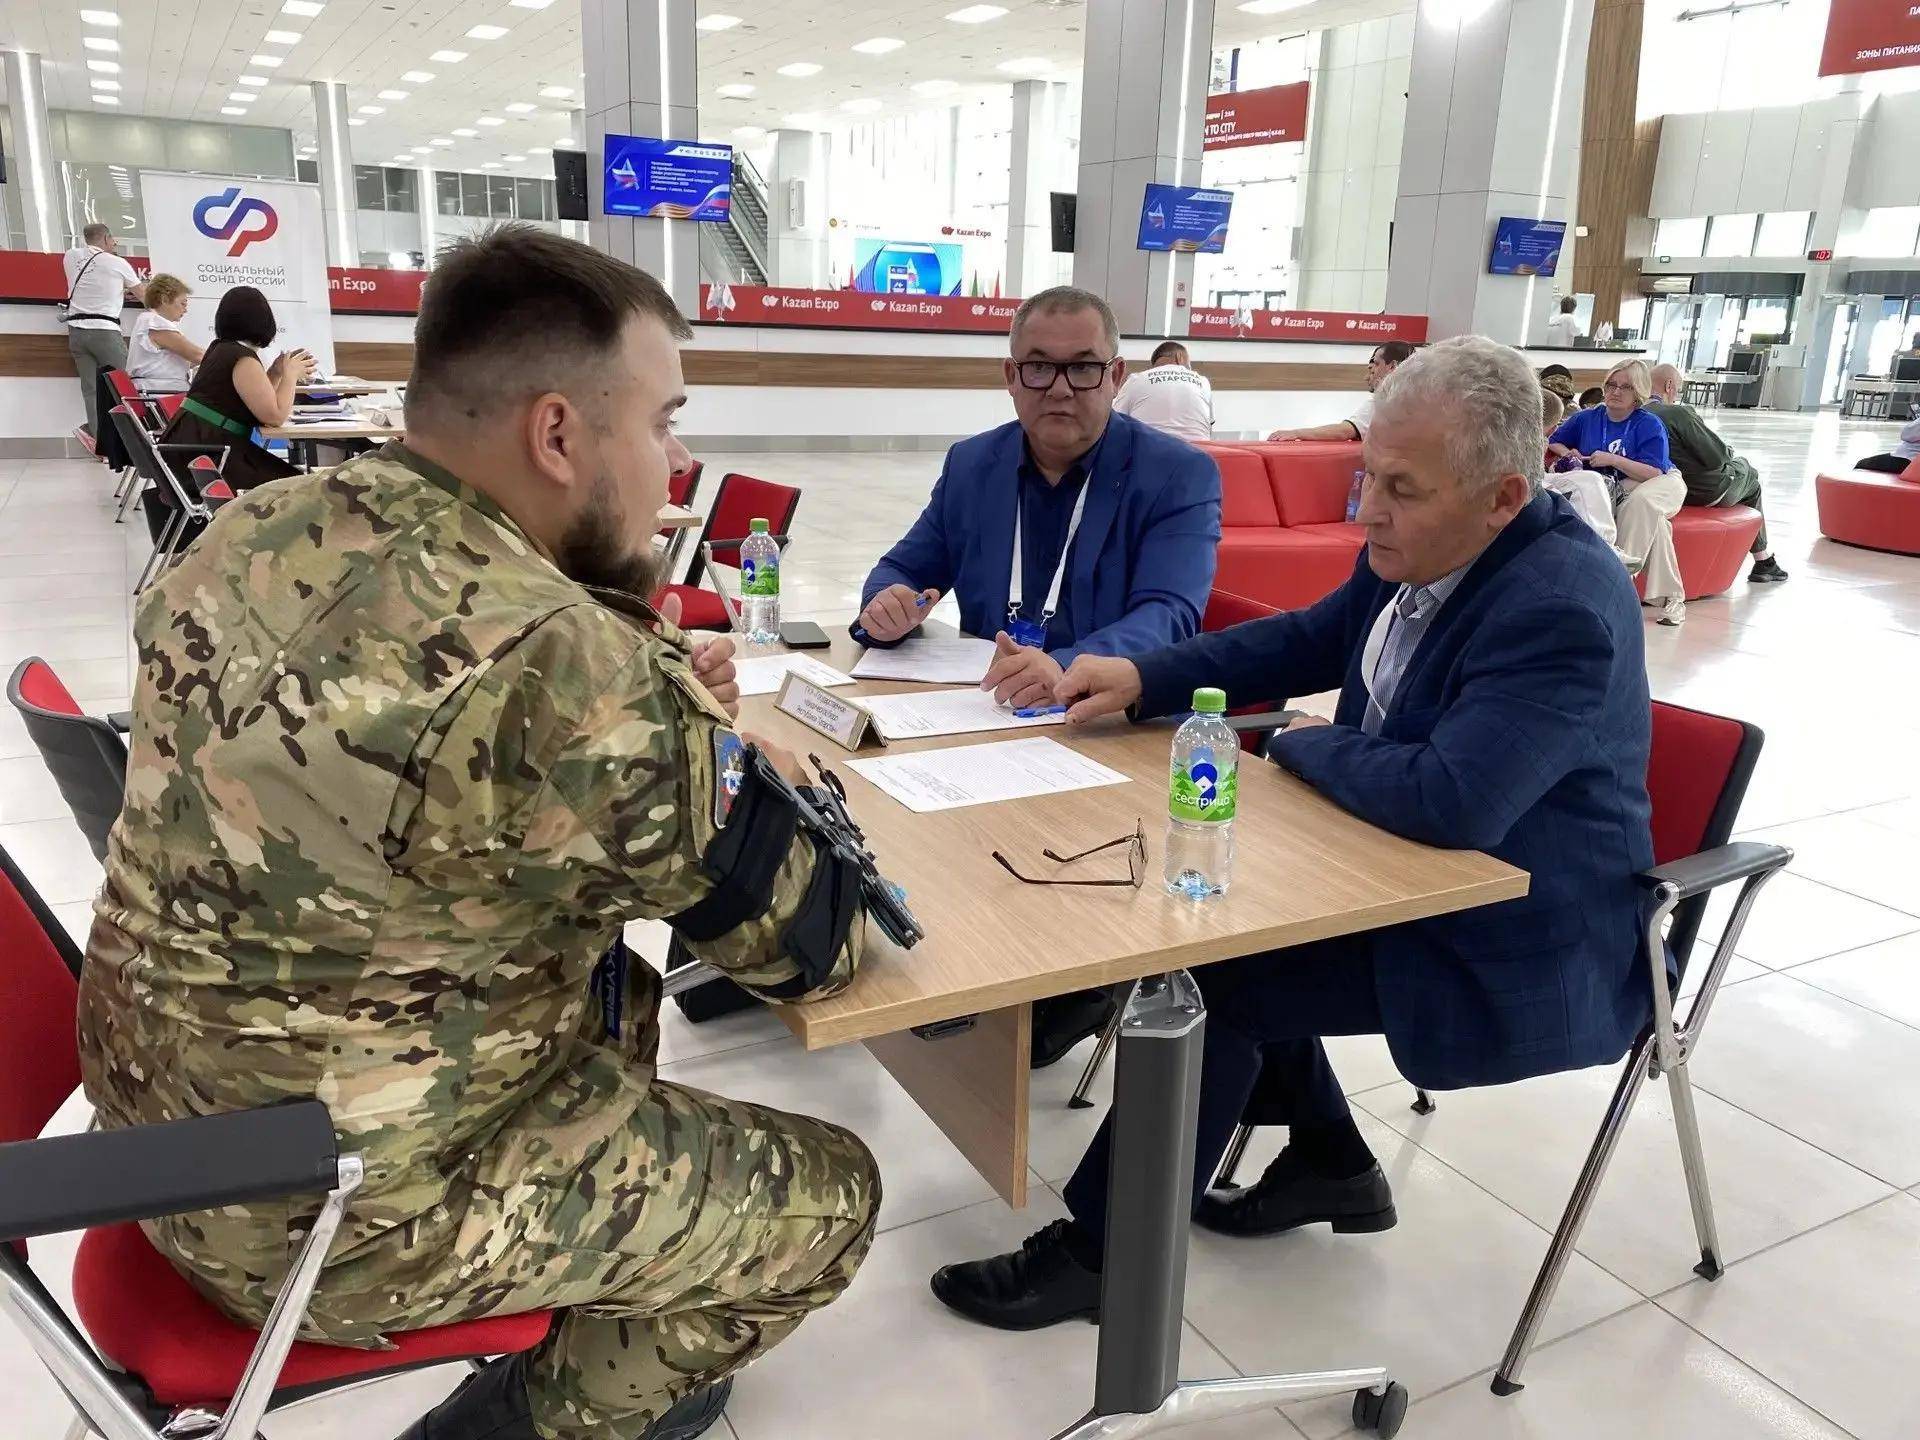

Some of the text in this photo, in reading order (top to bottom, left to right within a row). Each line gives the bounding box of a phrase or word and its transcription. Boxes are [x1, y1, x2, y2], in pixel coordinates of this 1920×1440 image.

[1855, 49, 1881, 60] ЗОНЫ
[956, 228, 992, 238] Kazan Expo
[197, 264, 285, 276] СОЦИАЛЬНЫЙ
[198, 274, 286, 286] ФОНД РОССИИ
[343, 276, 377, 294] Expo
[782, 295, 839, 311] Kazan Expo
[889, 300, 943, 315] Kazan Expo
[989, 305, 1015, 317] Kazan
[1205, 314, 1228, 325] Kazan
[1284, 317, 1325, 330] Kazan Expo
[1358, 319, 1396, 332] Kazan Expo
[1149, 376, 1202, 388] ТАТАРСТАН
[1175, 792, 1229, 807] сестрица
